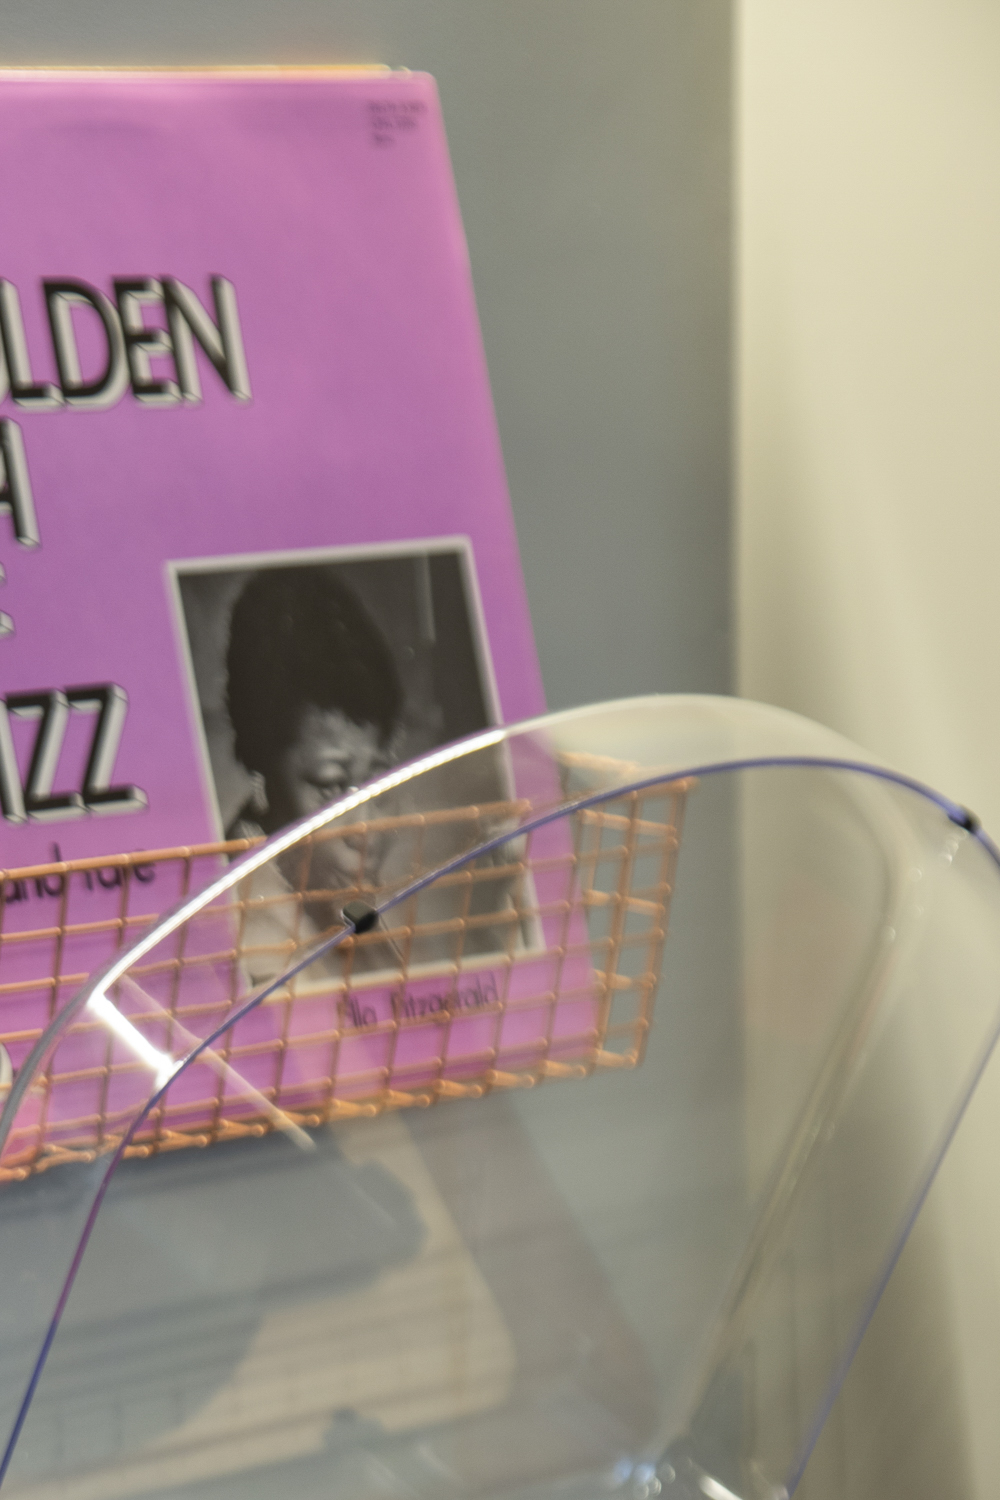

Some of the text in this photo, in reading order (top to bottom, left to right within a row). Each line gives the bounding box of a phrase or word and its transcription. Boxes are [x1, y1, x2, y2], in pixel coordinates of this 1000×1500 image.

[82, 850, 155, 891] ae
[337, 970, 500, 1028] lla Fitzgrald
